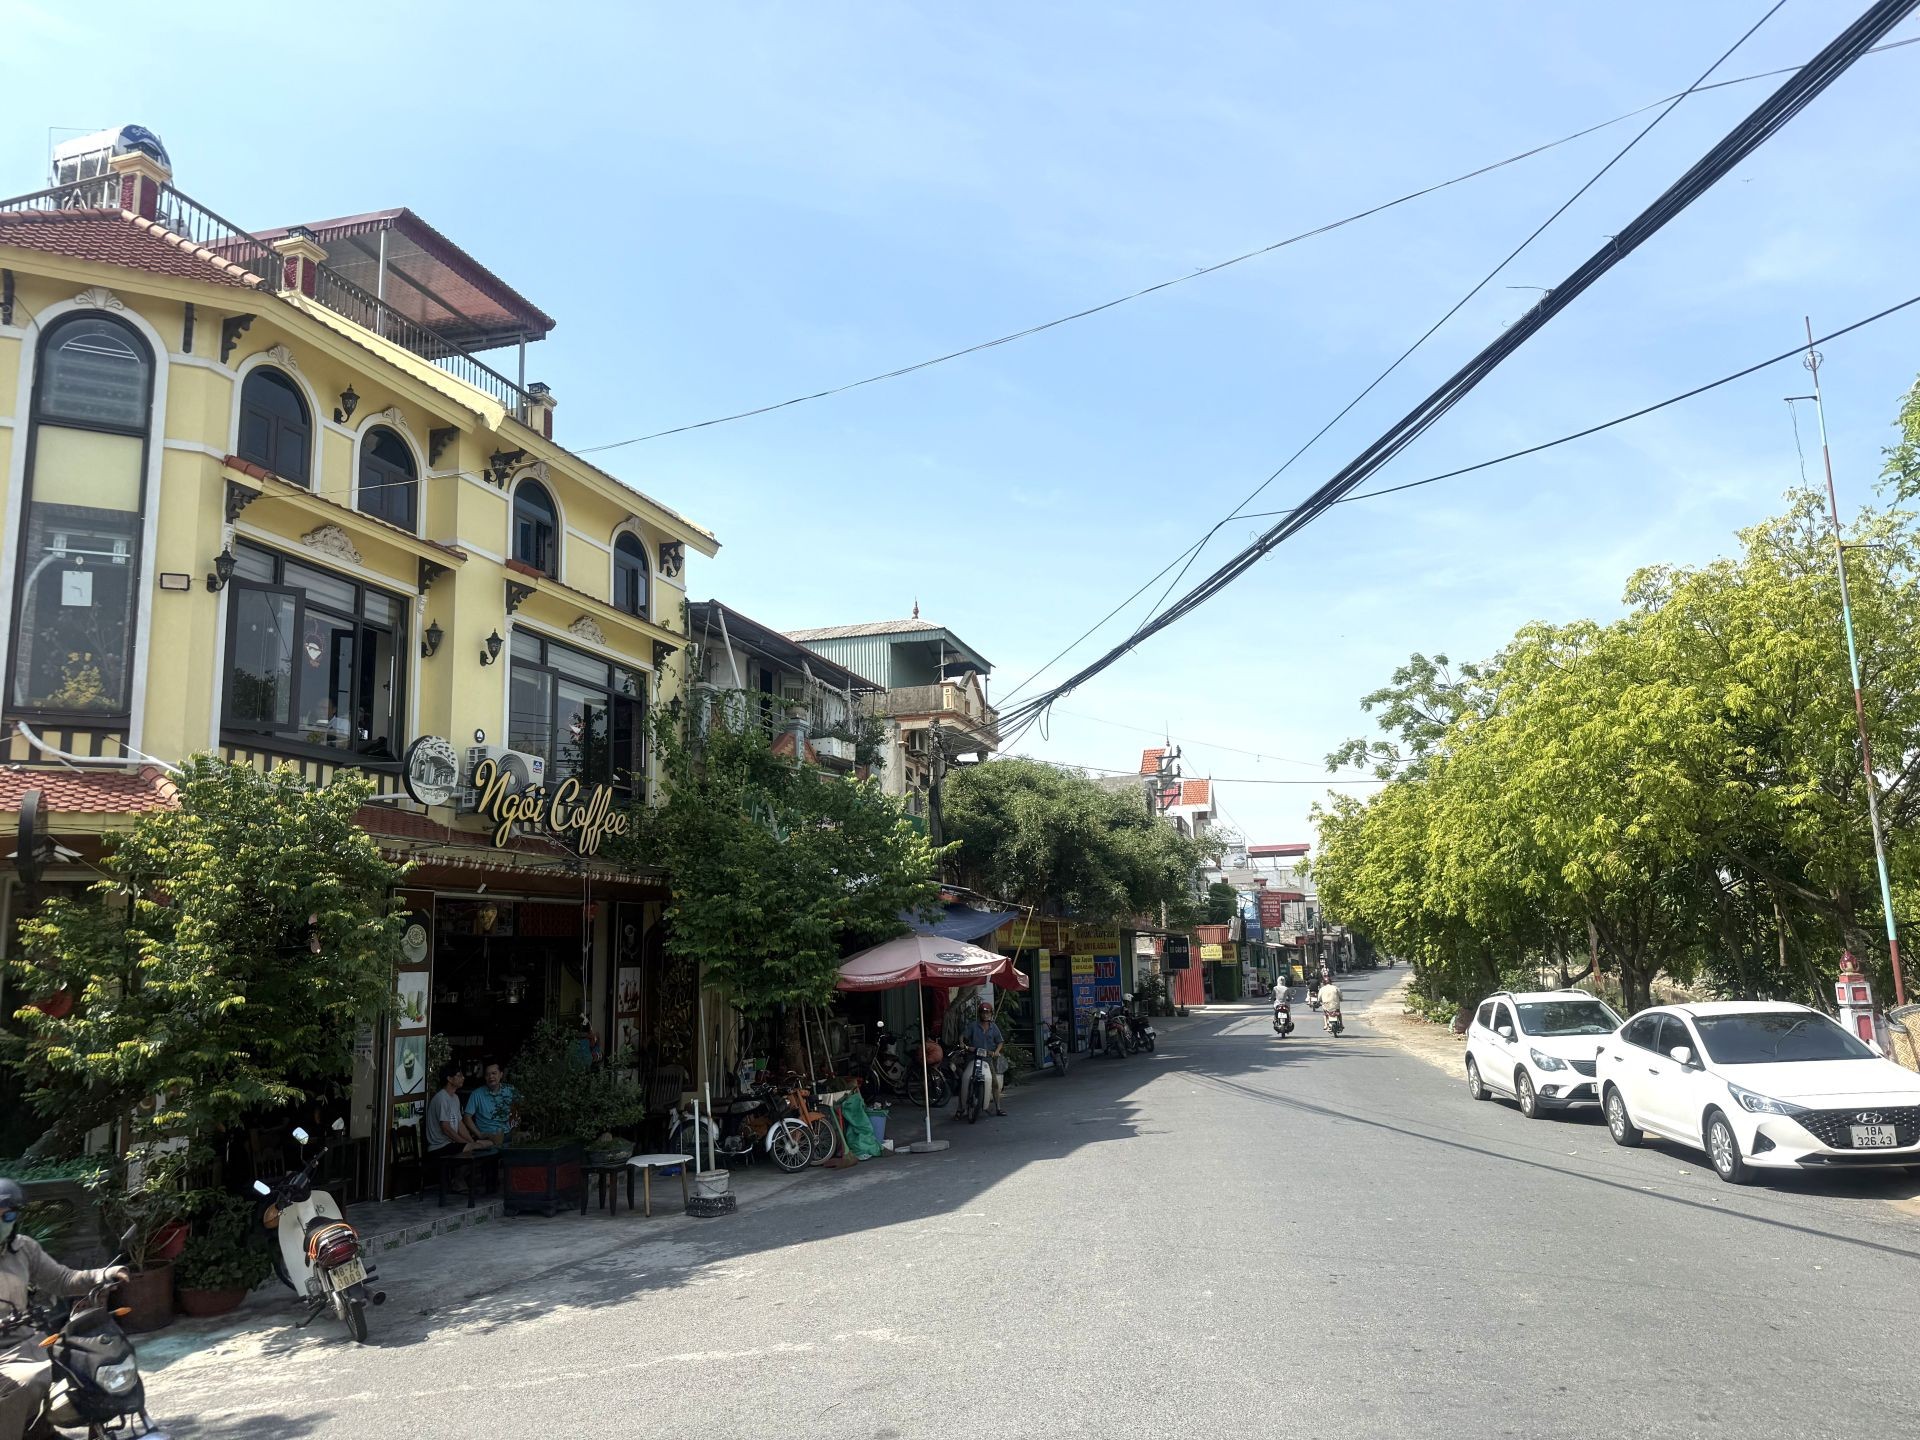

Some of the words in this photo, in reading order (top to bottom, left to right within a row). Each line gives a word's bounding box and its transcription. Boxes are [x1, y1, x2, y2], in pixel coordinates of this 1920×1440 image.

[475, 758, 545, 848] Ngói
[550, 778, 628, 855] Coffee
[1865, 1126, 1883, 1136] 18A
[1857, 1136, 1892, 1146] 326.43
